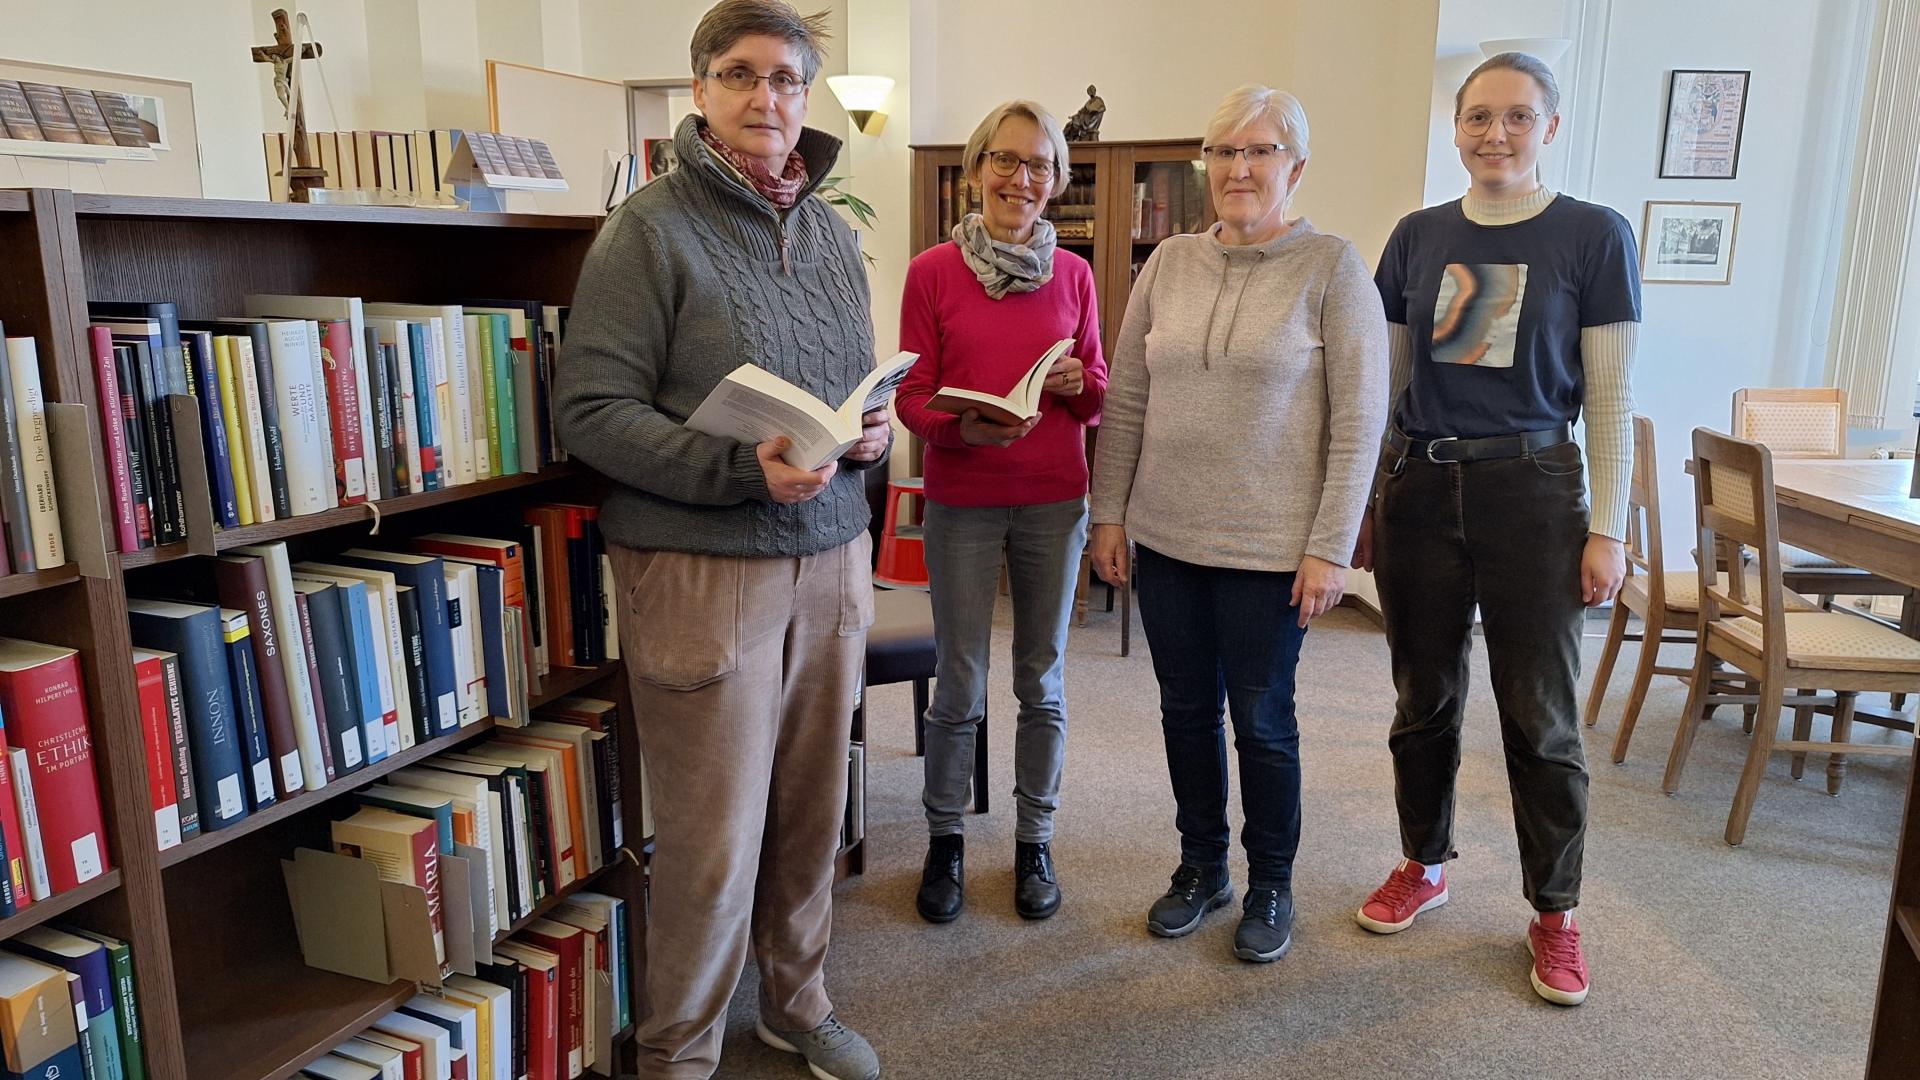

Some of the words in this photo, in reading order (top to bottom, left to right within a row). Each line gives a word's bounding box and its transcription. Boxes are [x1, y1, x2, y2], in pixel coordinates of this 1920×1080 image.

[452, 313, 464, 349] glauben
[182, 346, 194, 382] JUNGEN
[454, 351, 466, 396] Christlich
[105, 370, 116, 408] stürmischer
[289, 384, 300, 416] WERTE
[342, 368, 354, 432] ENTSTEHUNG
[28, 388, 44, 442] Bergpredigt
[269, 425, 278, 444] Wolf
[36, 443, 45, 462] Die
[116, 450, 125, 476] Wächter
[130, 451, 140, 469] Wolf
[273, 445, 283, 470] Hubert
[120, 482, 128, 501] Rusch
[133, 470, 144, 495] Hubert
[36, 484, 45, 513] EBERHARD
[123, 502, 131, 524] Paulus
[176, 490, 187, 536] Kohlhammer
[48, 533, 56, 557] HERDER
[256, 590, 276, 657] SAXONES
[301, 602, 311, 626] MAGIE
[309, 644, 318, 669] VISION
[44, 681, 69, 694] KONRAD
[167, 662, 178, 696] GEHIRNE
[36, 690, 62, 705] HILPERT
[171, 696, 184, 744] VERSKLAVTE
[206, 688, 225, 745] NONNI
[36, 736, 92, 767] ETHIK
[179, 747, 188, 775] Gehring
[47, 764, 58, 774] IM
[182, 775, 191, 799] Heiner
[182, 813, 198, 824] KOPP
[3, 879, 12, 905] HERDER
[426, 842, 441, 917] MARIA
